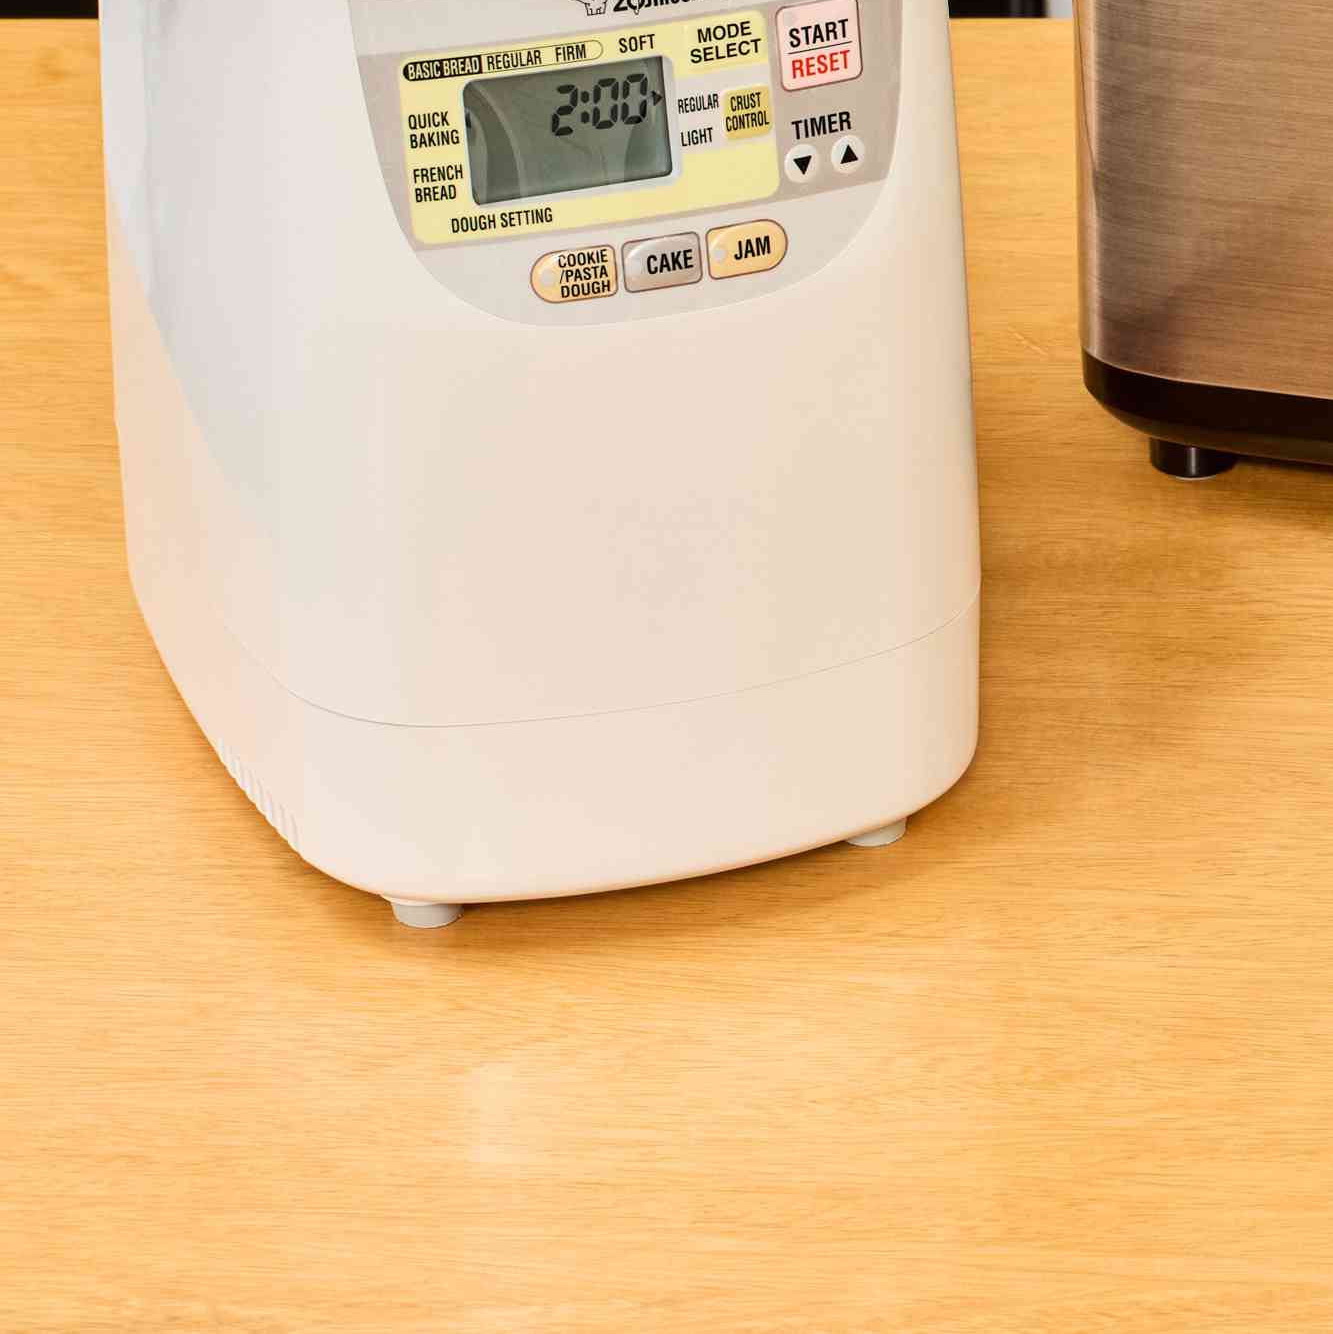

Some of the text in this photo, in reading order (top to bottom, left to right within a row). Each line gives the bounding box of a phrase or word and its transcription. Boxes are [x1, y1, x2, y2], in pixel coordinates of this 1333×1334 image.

[697, 21, 752, 43] MODE
[789, 19, 849, 48] START
[487, 34, 655, 71] REGULAR FIRM SOFT
[690, 38, 762, 64] SELECT
[408, 57, 480, 80] BASIC BREAD
[792, 50, 850, 79] RESET
[552, 73, 648, 136] 2:00
[678, 93, 719, 114] REGULAR
[730, 92, 761, 112] CRUST
[408, 111, 450, 130] QUICK
[726, 110, 769, 132] CONTROL
[792, 111, 852, 140] TIMER
[410, 129, 460, 149] BAKING
[680, 127, 713, 147] LIGHT
[413, 164, 464, 184] FRENCH
[415, 185, 457, 203] BREAD
[451, 207, 553, 233] DOUGH SETTING
[558, 249, 608, 268] COOKIE
[734, 235, 771, 261] JAM
[647, 249, 694, 275] CAKE
[560, 266, 608, 284] /PASTA
[561, 280, 610, 299] DOUGH
